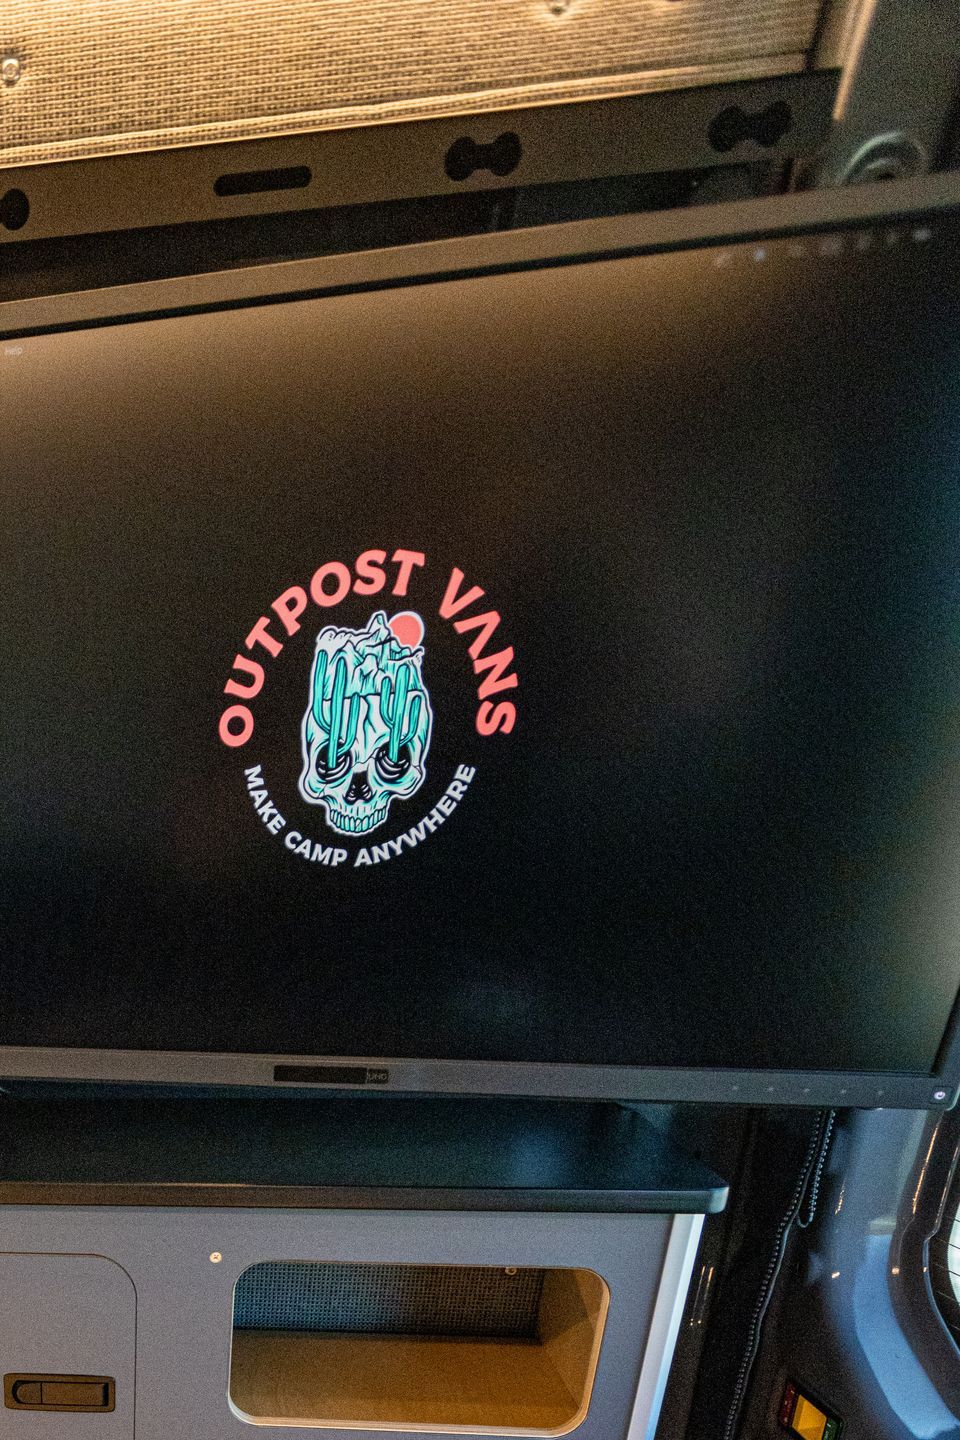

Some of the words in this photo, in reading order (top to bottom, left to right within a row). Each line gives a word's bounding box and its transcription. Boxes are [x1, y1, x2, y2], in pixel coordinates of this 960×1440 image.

[219, 549, 425, 747] OUTPOST
[439, 567, 518, 736] VANS
[244, 764, 286, 834] MAKE
[284, 831, 348, 866] CAMP
[353, 764, 476, 867] ANYWHERE
